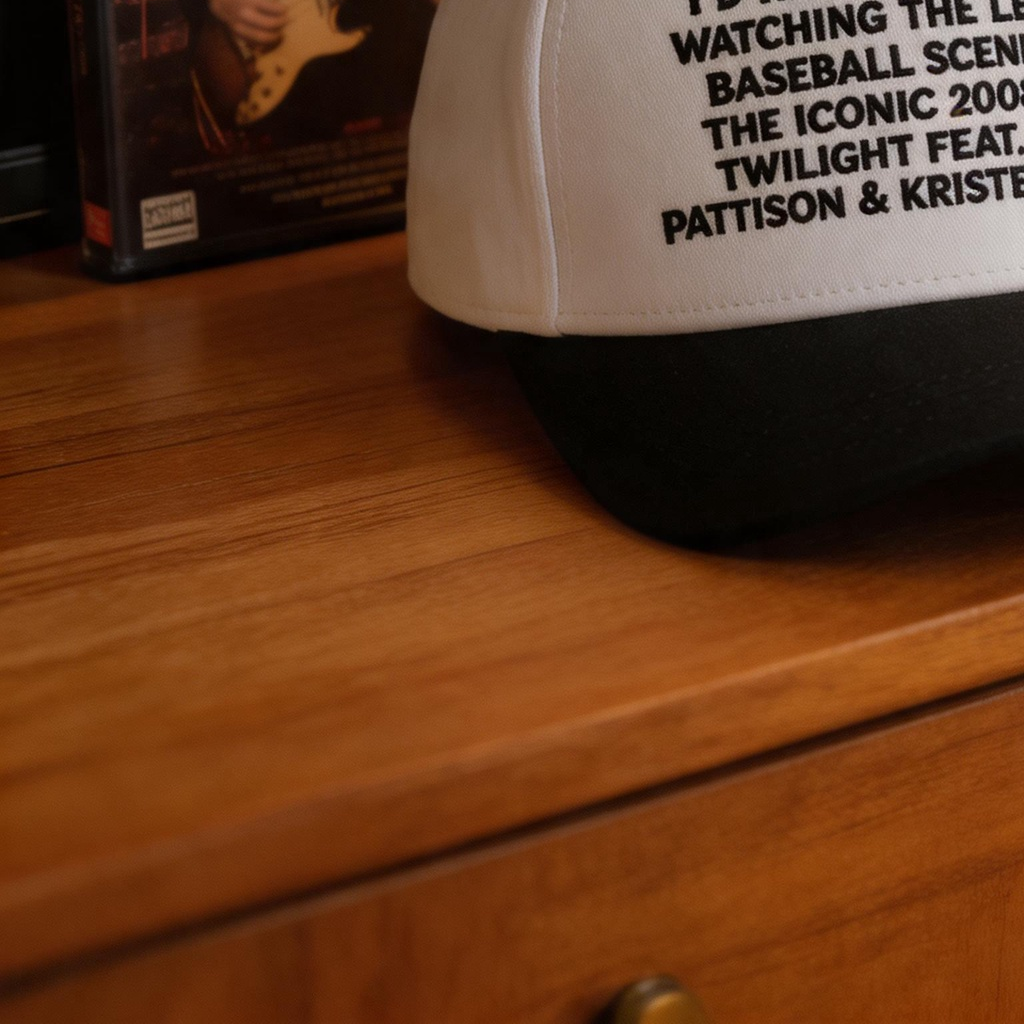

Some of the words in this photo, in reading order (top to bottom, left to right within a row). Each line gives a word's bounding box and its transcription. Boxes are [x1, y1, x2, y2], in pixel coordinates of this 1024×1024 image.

[669, 0, 887, 65] WATCHING
[705, 44, 915, 107] BASEBALL
[700, 108, 783, 151] THE
[794, 87, 938, 137] ICONIC
[715, 134, 913, 191] TWILIGHT
[926, 123, 1024, 163] FEAT.
[661, 186, 846, 245] PATTISON
[859, 180, 890, 215] &
